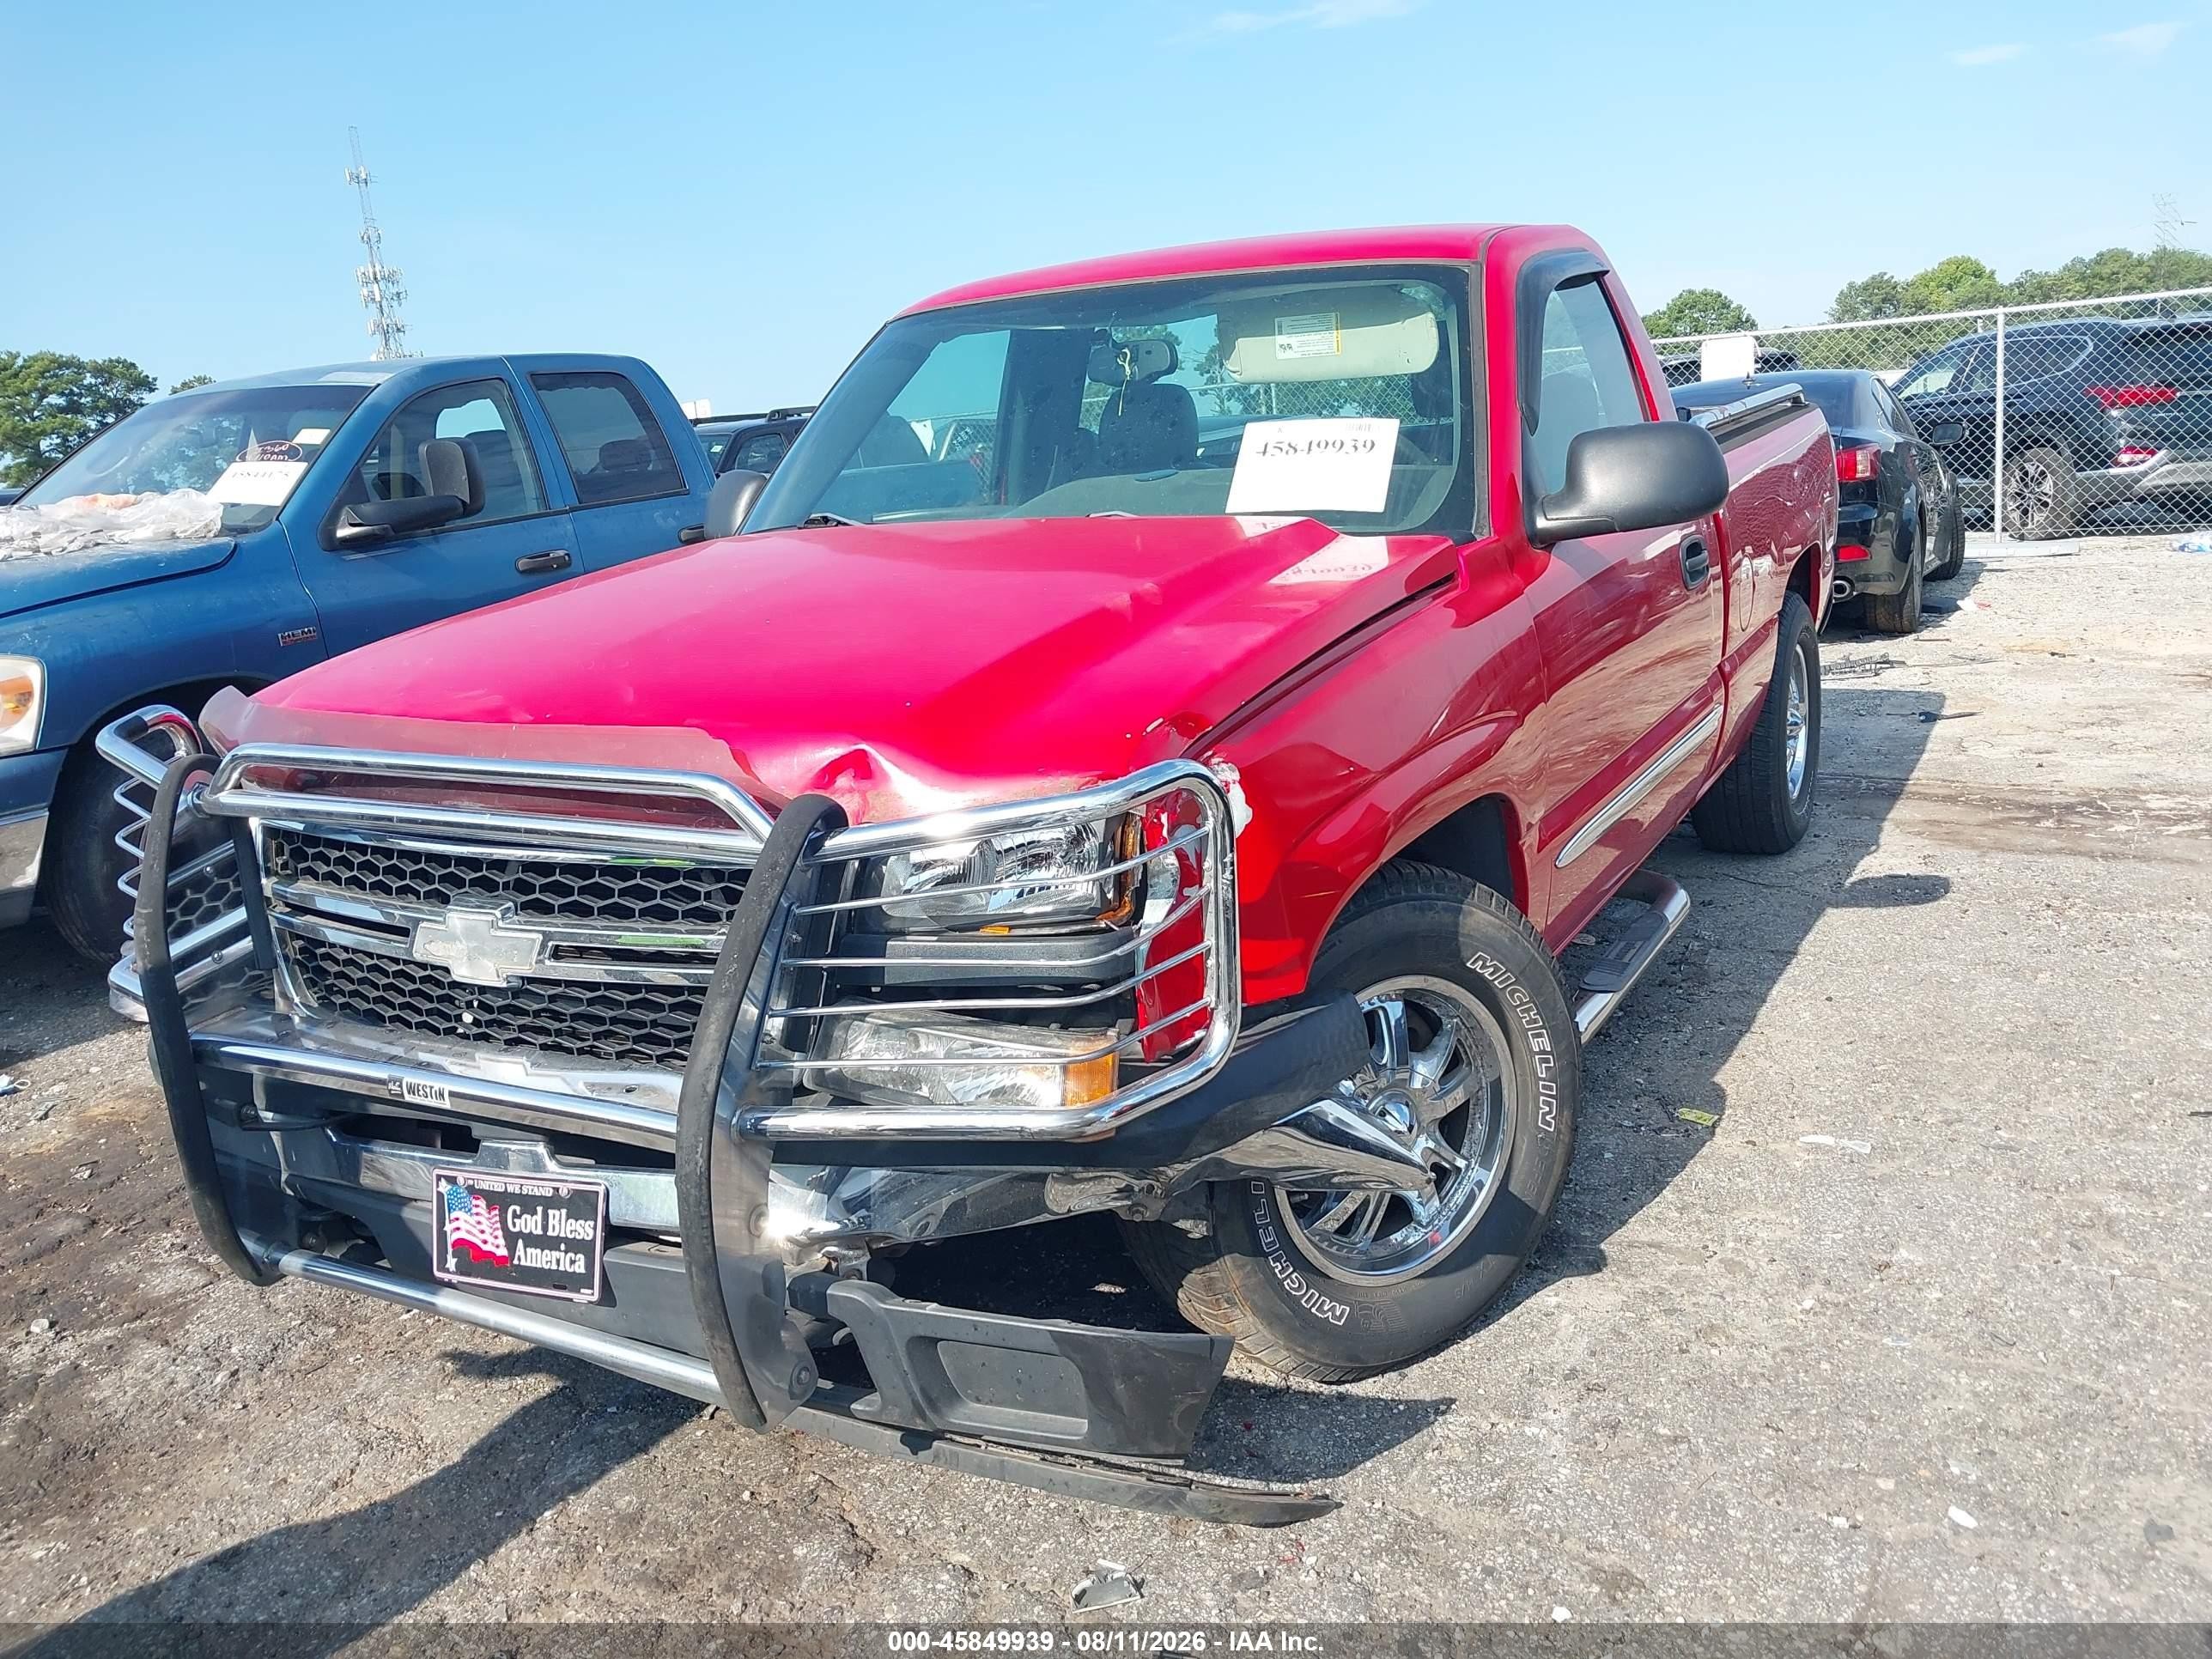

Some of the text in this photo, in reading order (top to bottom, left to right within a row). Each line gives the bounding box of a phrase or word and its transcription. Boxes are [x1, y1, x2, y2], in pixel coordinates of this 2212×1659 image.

[1255, 439, 1376, 457] 45849939
[279, 627, 316, 641] HEMI
[1466, 951, 1557, 1132] MICHELIN
[474, 1180, 554, 1197] UNITED WE STAND
[507, 1205, 594, 1241] God Bless
[513, 1238, 586, 1273] America
[1250, 1181, 1350, 1325] MICHELI
